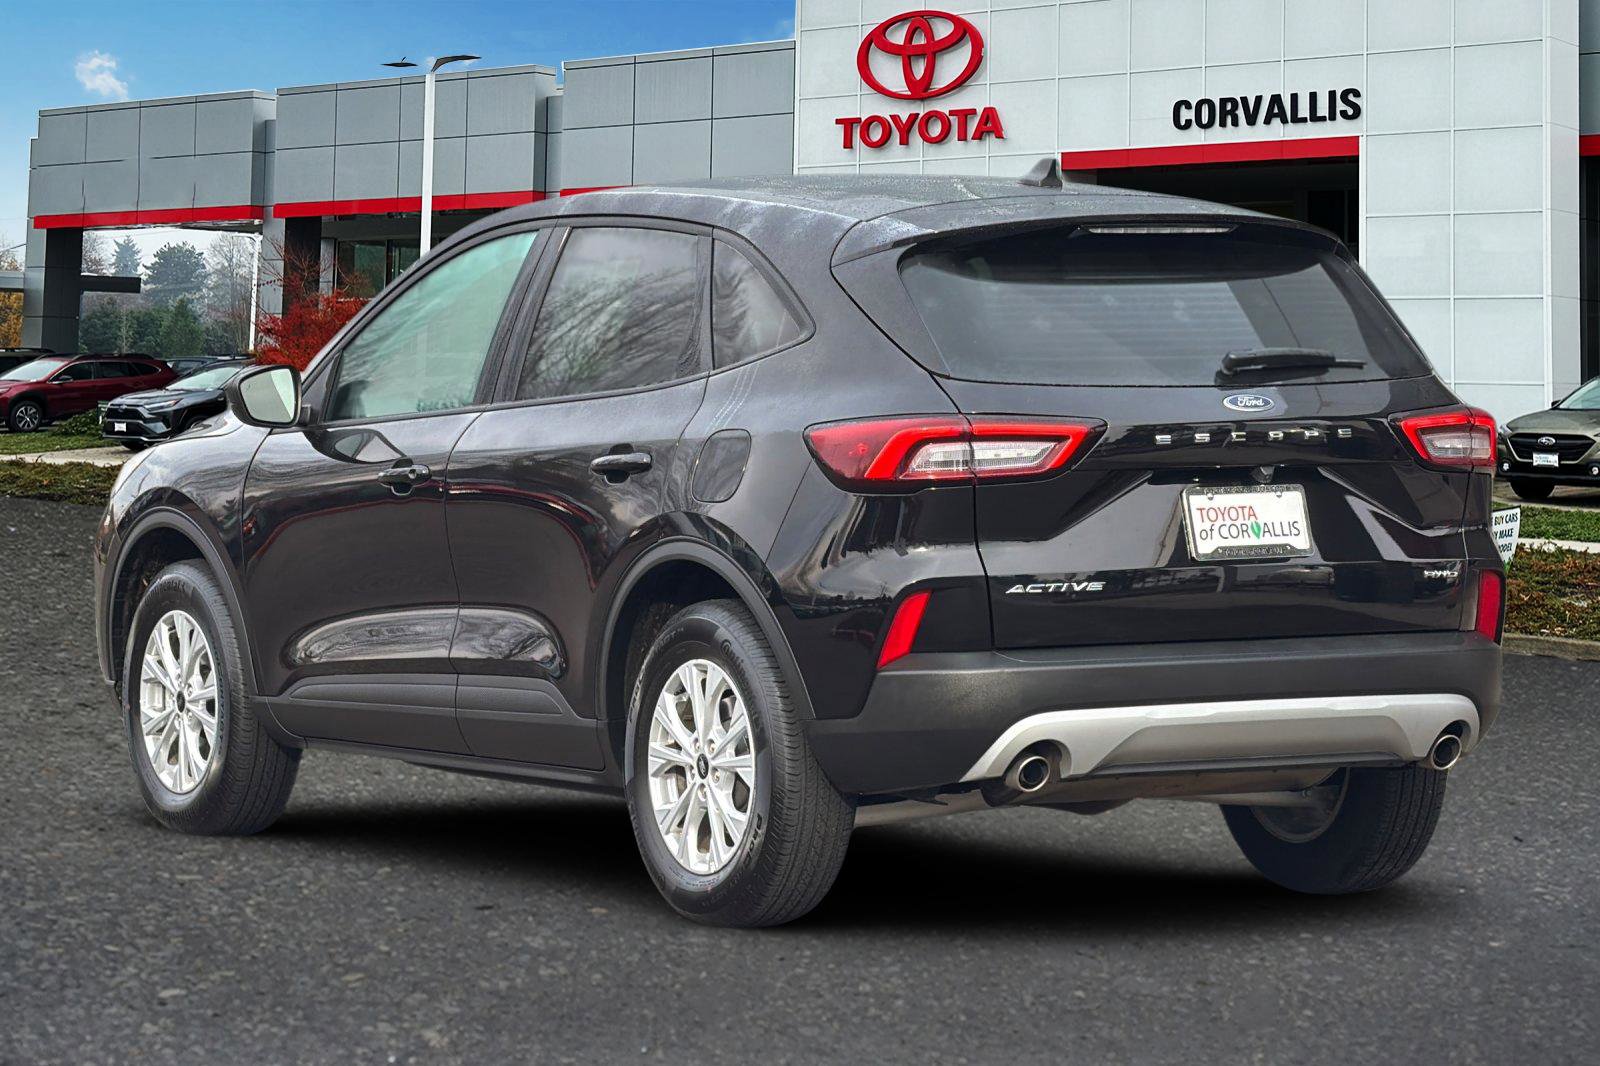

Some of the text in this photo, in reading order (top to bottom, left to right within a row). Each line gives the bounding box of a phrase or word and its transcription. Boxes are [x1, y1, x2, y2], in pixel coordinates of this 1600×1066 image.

[1172, 87, 1362, 131] CORVALLIS
[835, 106, 1005, 149] TOYOTA
[1237, 396, 1265, 407] Ford
[1155, 427, 1352, 445] ESCAPE
[1196, 505, 1258, 523] TOYOTA
[1199, 521, 1300, 541] of CORVALLIS
[1005, 581, 1106, 594] ACTIVE
